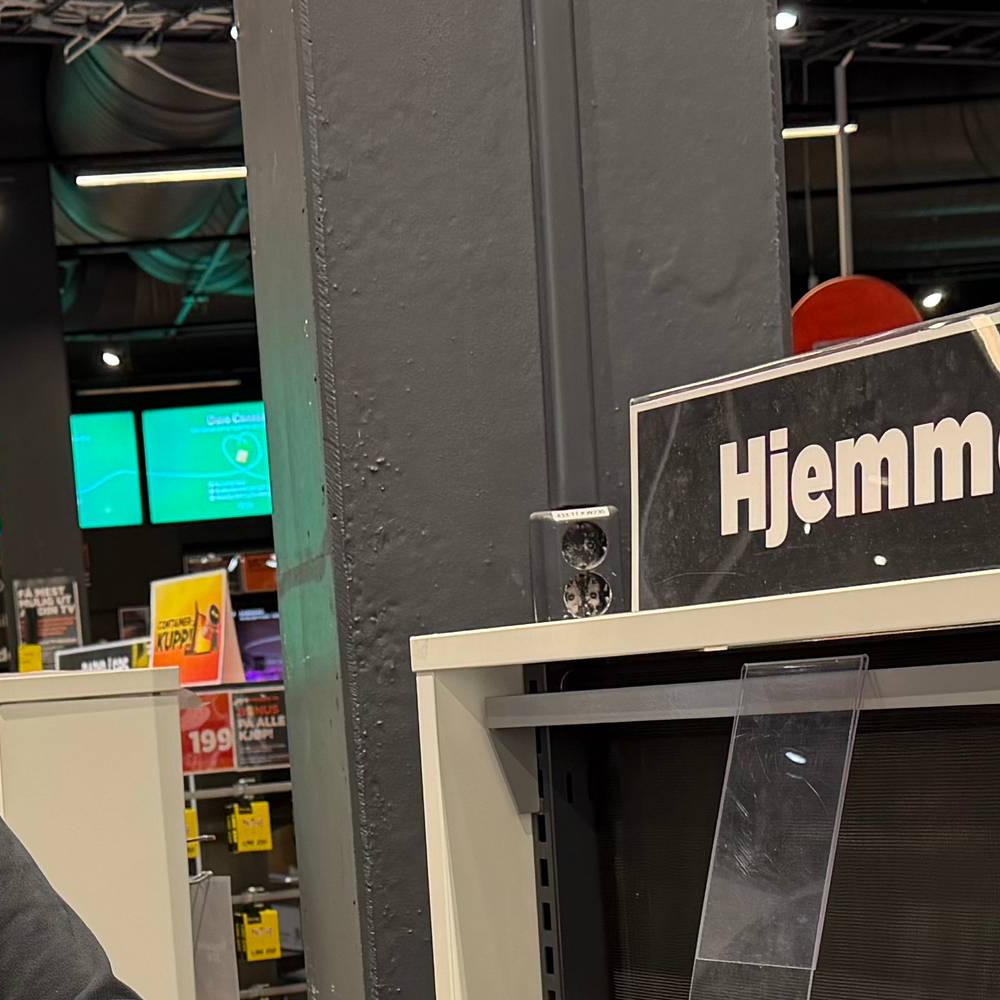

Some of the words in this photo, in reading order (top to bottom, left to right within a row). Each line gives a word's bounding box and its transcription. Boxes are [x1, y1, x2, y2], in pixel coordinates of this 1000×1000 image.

[719, 411, 1000, 549] Hjemm
[256, 714, 286, 728] ALLE
[188, 729, 234, 754] 199
